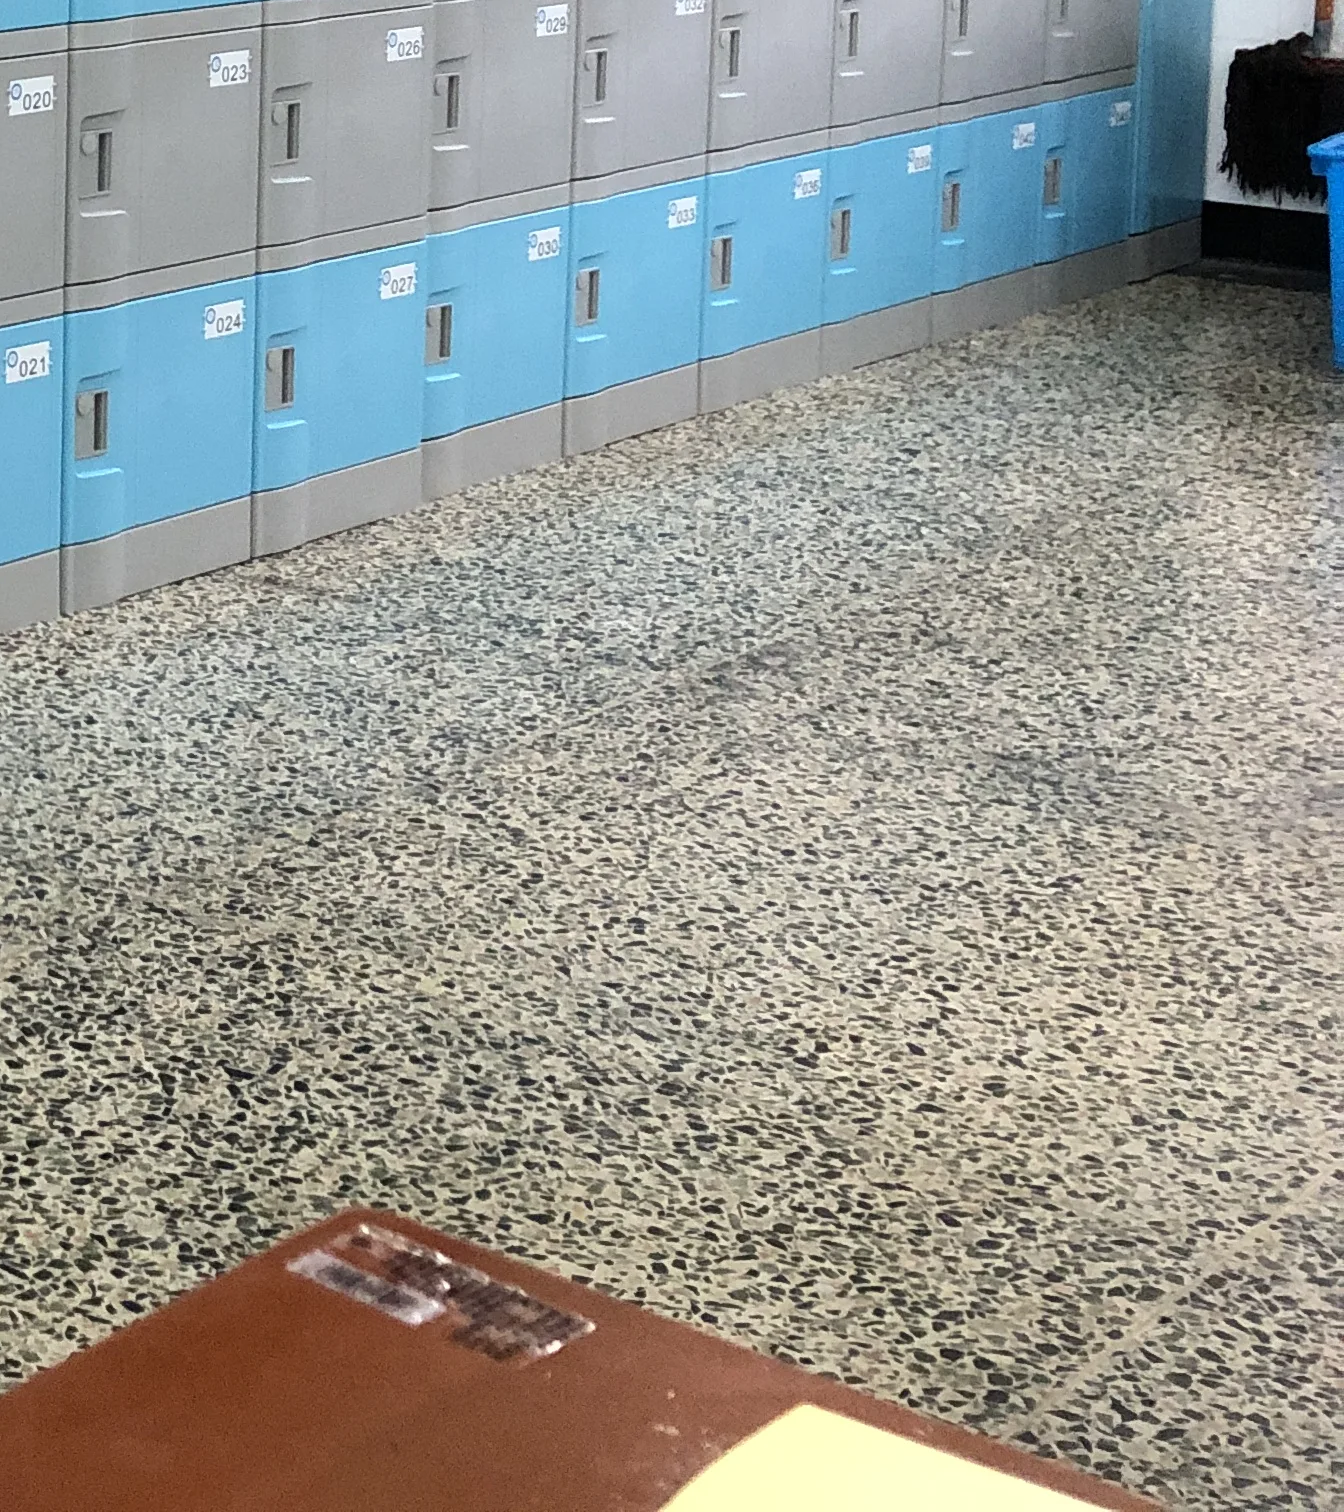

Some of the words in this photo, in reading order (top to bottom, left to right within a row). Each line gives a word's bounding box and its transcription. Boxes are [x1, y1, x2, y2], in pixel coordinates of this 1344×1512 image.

[545, 15, 567, 34] 029
[397, 39, 421, 57] 026
[220, 62, 249, 83] 023
[21, 90, 52, 112] 020
[676, 207, 696, 224] 033
[536, 238, 558, 257] 030
[390, 275, 415, 294] 027
[214, 312, 243, 334] 024
[17, 354, 49, 377] 021
